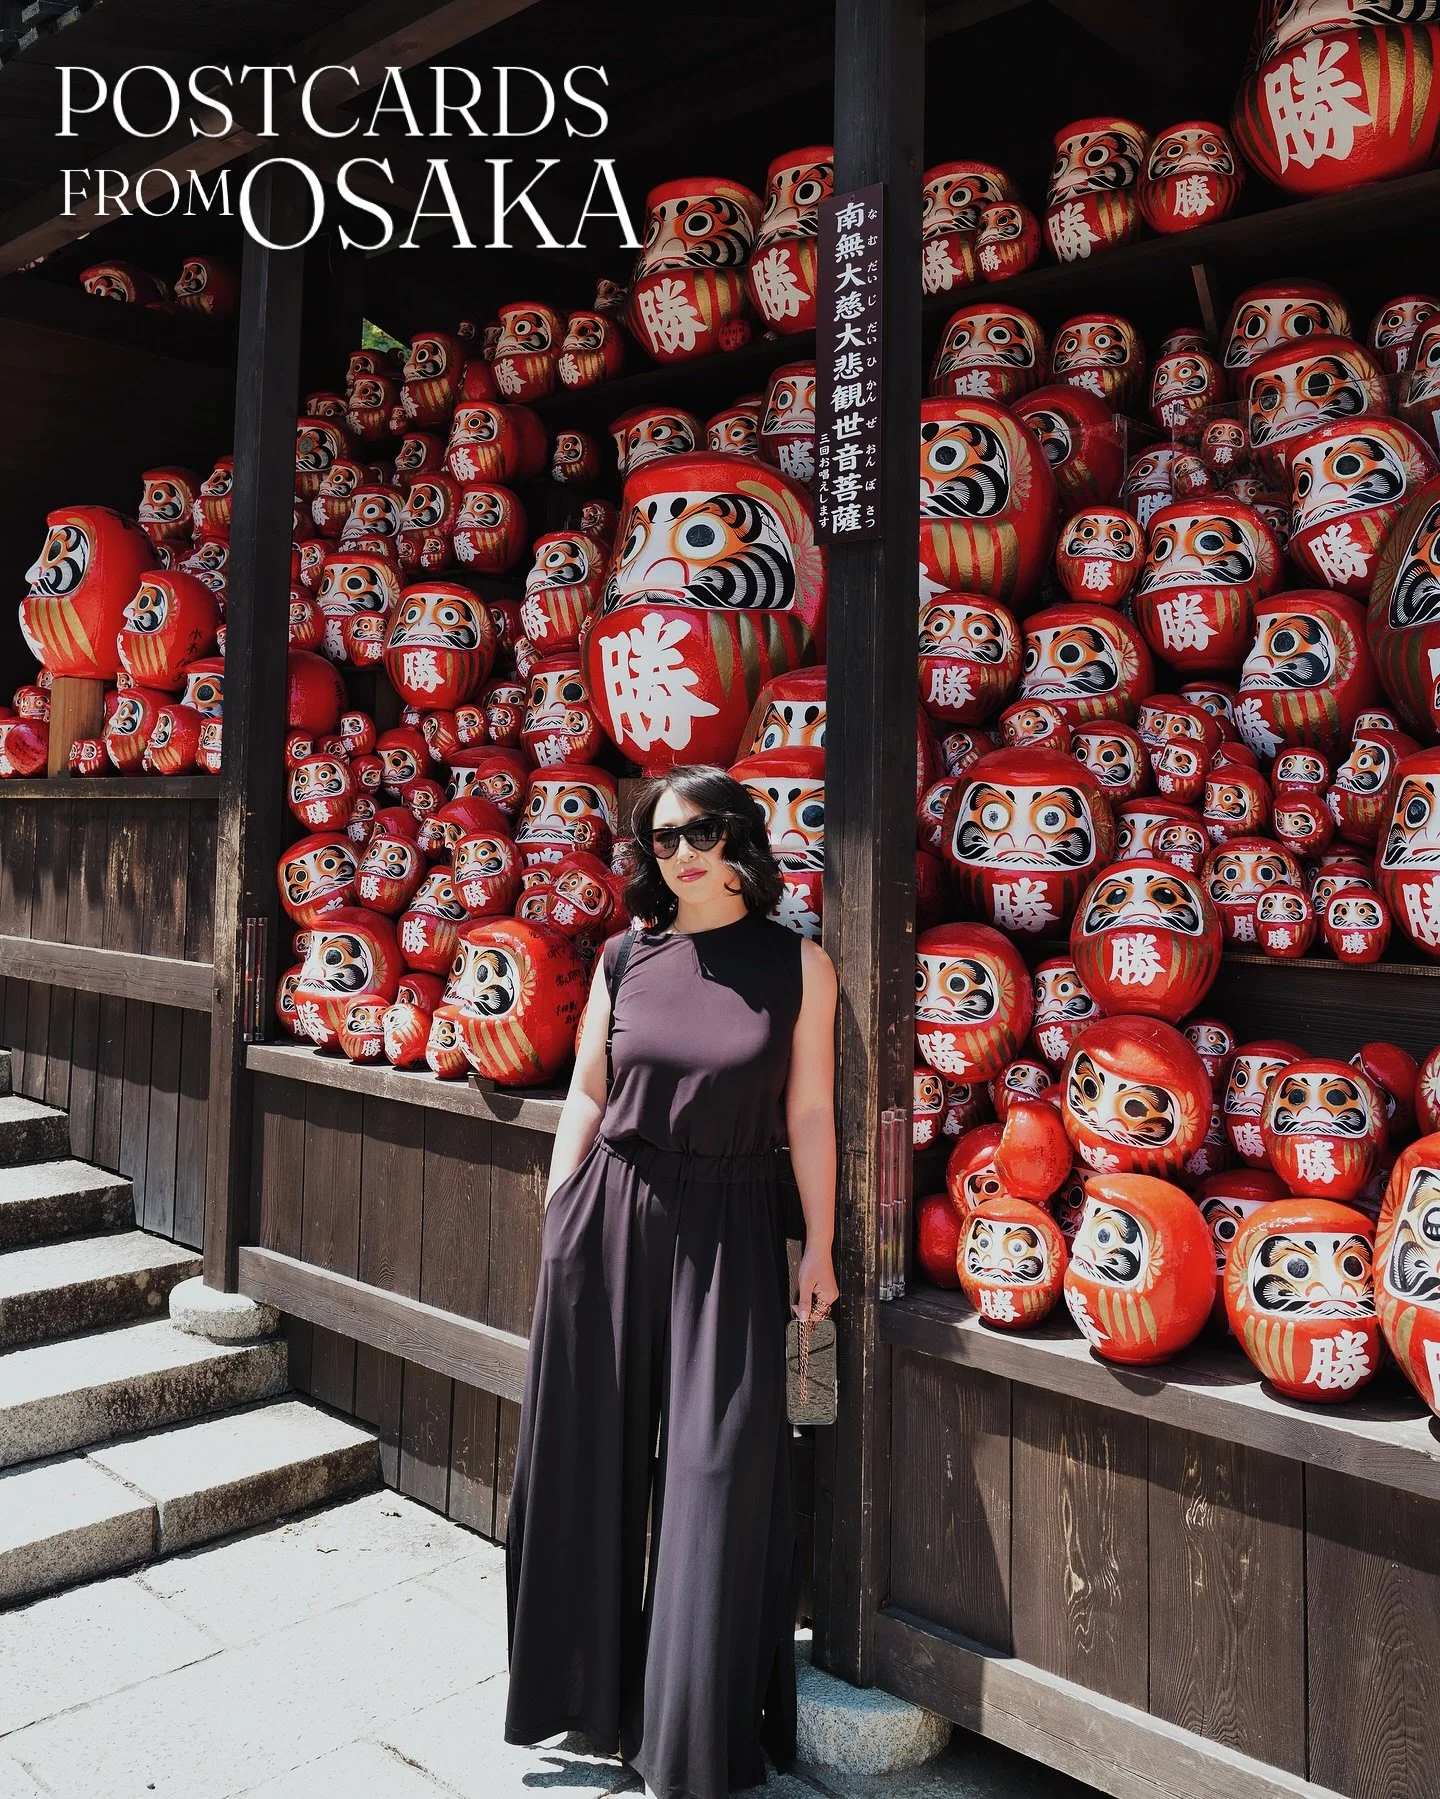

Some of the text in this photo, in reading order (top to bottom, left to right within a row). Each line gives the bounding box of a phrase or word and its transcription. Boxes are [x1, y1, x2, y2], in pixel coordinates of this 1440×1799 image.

[1264, 39, 1372, 174] 勝
[1173, 174, 1215, 218] 勝
[1048, 202, 1101, 263] 勝
[922, 239, 963, 295] 勝
[980, 245, 1002, 272] 勝
[752, 248, 810, 321] 勝
[638, 278, 708, 354] 勝
[494, 358, 526, 395] 勝
[558, 353, 581, 384] 勝
[830, 202, 867, 534] 南無大慈大悲観世音菩薩
[449, 447, 480, 481] 勝
[778, 440, 815, 482] 勝
[1212, 447, 1233, 464] 勝
[818, 433, 830, 529] 三回お唱えします
[1190, 470, 1209, 487] 勝
[454, 531, 480, 562] 勝
[1308, 522, 1374, 588] 勝
[1080, 560, 1114, 590] 勝
[520, 594, 551, 640] 勝
[1156, 592, 1220, 651] 勝
[403, 648, 444, 693] 勝
[598, 612, 719, 751] 勝
[927, 666, 976, 708] 勝
[1234, 698, 1284, 760] 勝
[1158, 775, 1174, 793] 勝
[306, 801, 333, 824] 勝
[361, 875, 381, 900] 勝
[462, 880, 490, 908] 勝
[992, 877, 1060, 932] 勝
[551, 900, 576, 925] 勝
[402, 918, 430, 954] 勝
[1267, 928, 1294, 949] 勝
[1341, 932, 1368, 953] 勝
[1110, 933, 1166, 985] 勝
[297, 1000, 335, 1043] 勝
[361, 1038, 381, 1056] 勝
[917, 1031, 973, 1075] 勝
[1039, 1026, 1070, 1061] 勝
[1233, 1124, 1266, 1158] 勝
[1295, 1141, 1342, 1184] 勝
[979, 1288, 1021, 1323] 勝
[1303, 1329, 1371, 1390] 勝
